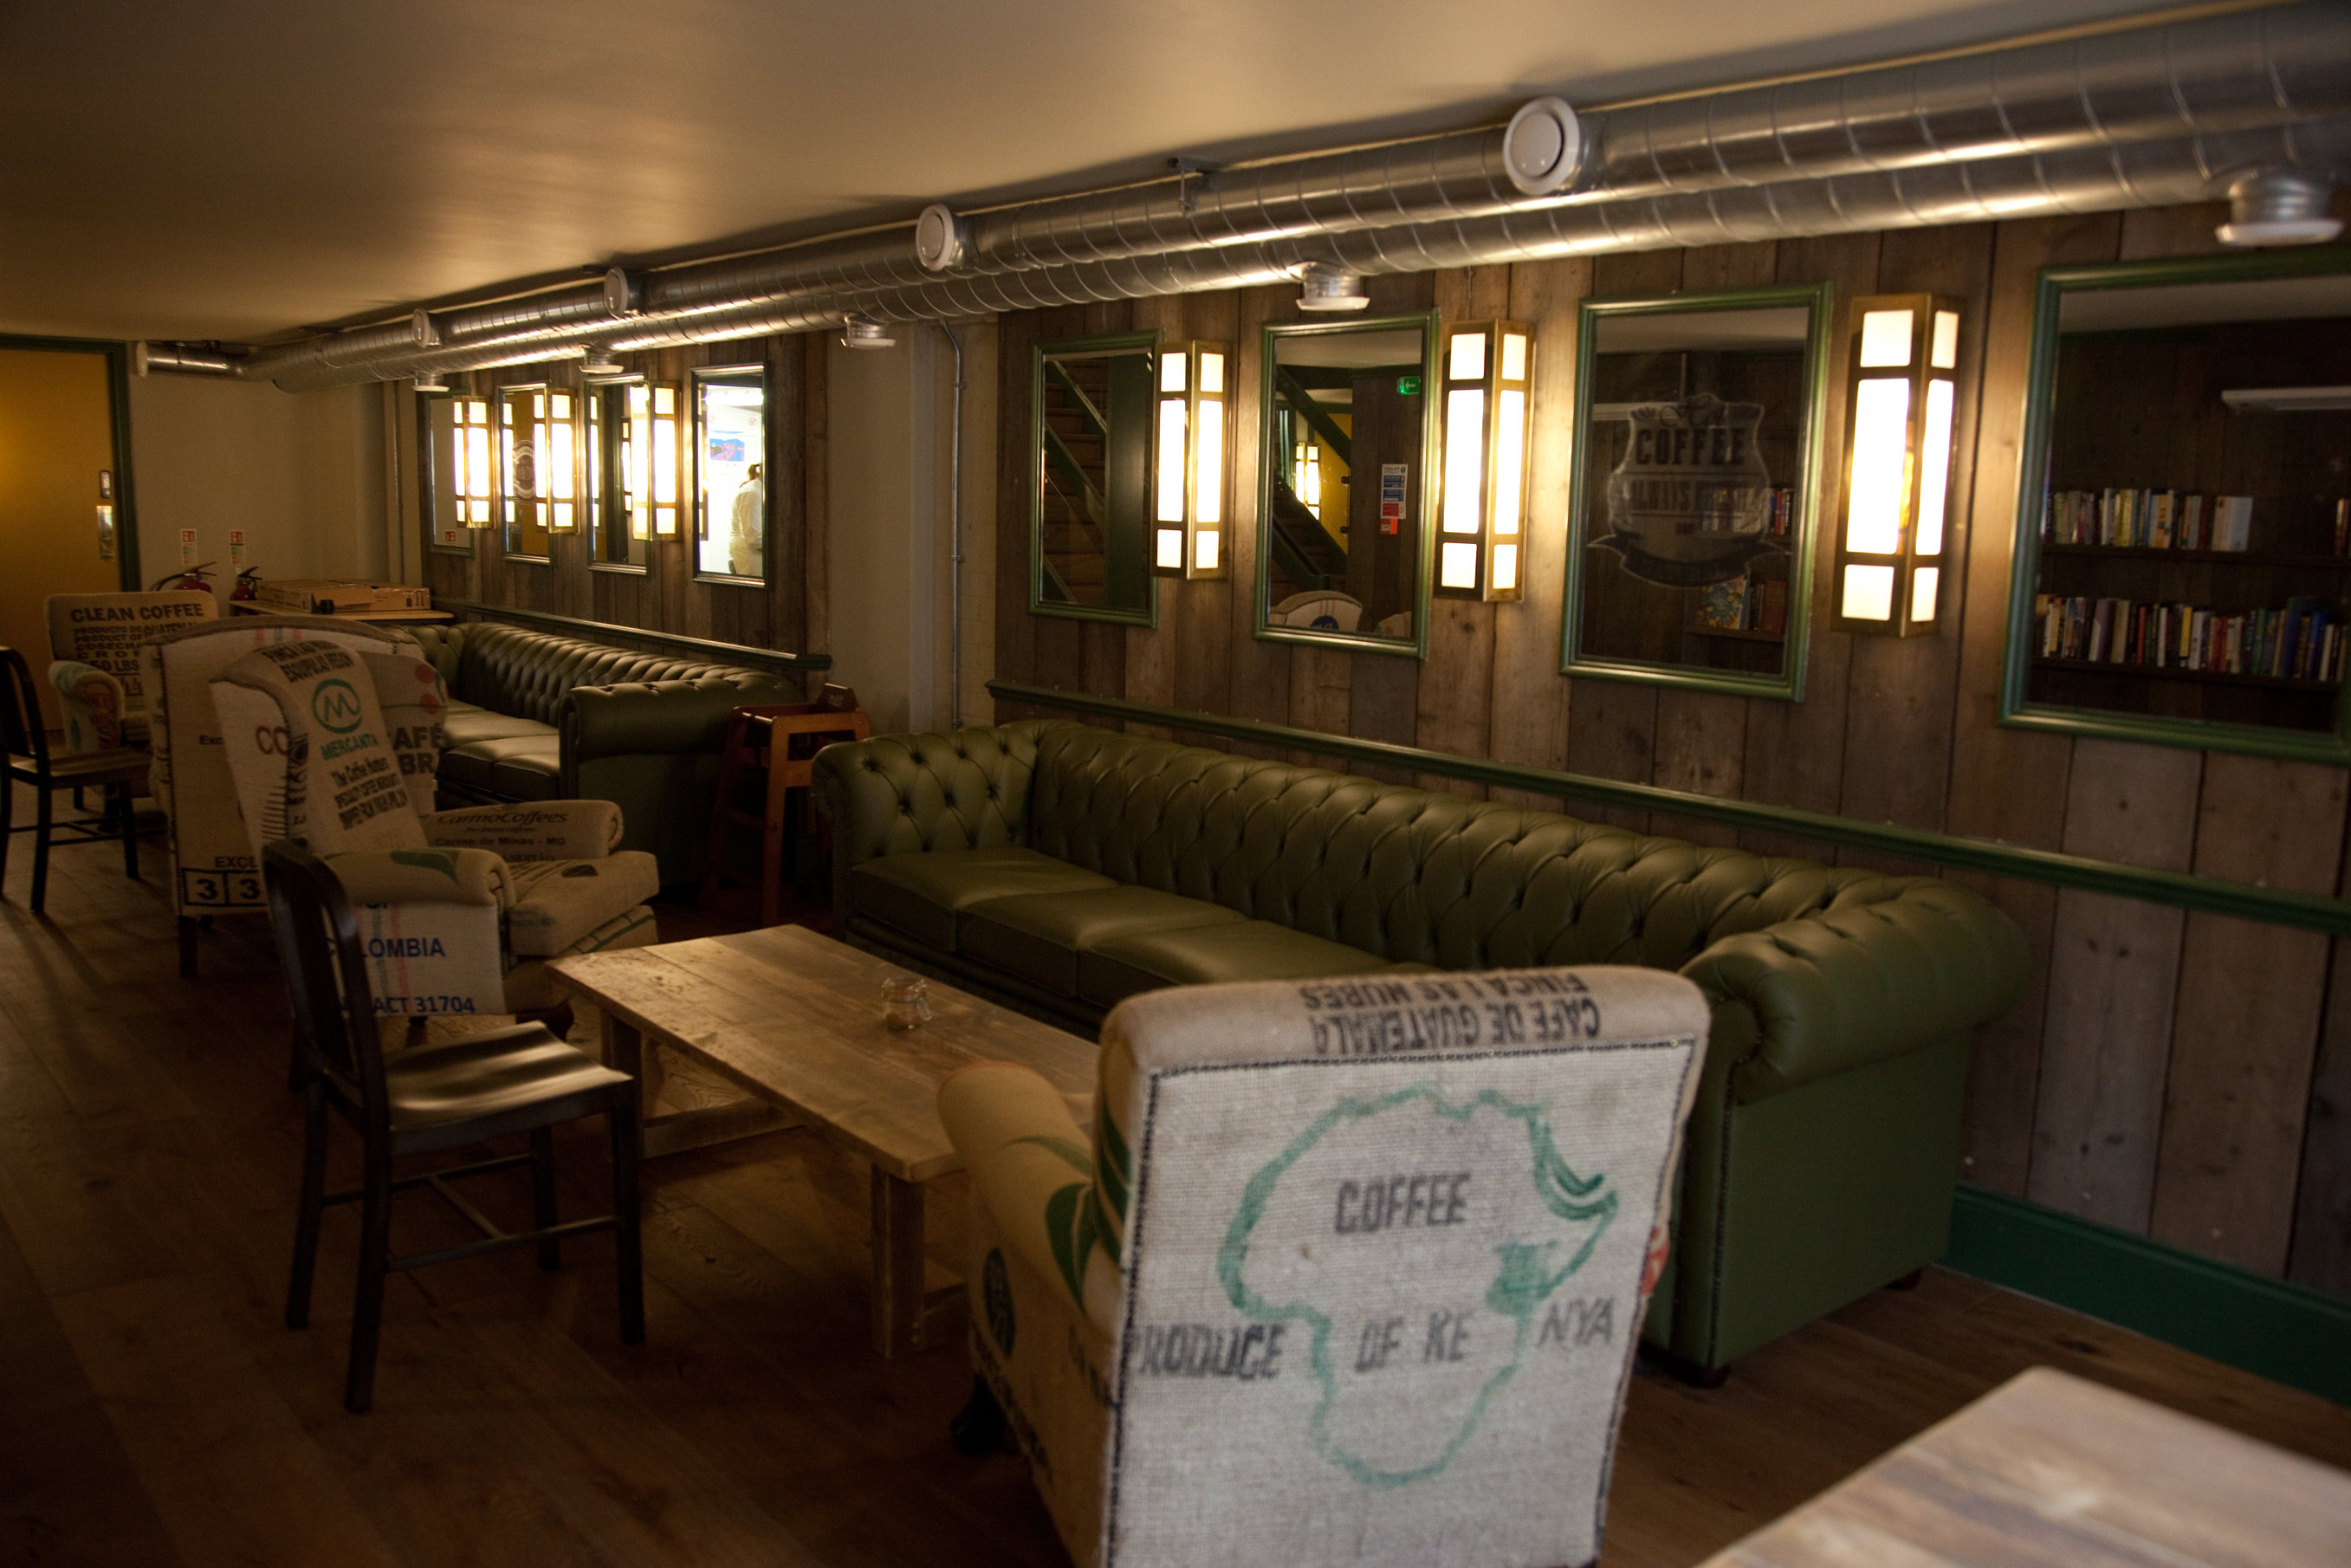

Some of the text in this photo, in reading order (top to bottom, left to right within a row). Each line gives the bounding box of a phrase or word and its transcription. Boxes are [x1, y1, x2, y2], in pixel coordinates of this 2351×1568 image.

[1636, 428, 1745, 465] COFFEE
[71, 603, 204, 622] CLEAN COFFEE
[74, 625, 126, 634] PRODUCTO
[75, 634, 126, 644] PRODUCT
[113, 659, 140, 672] LBS
[392, 722, 444, 750] AFÉ
[320, 734, 379, 761] MERCANTA
[437, 810, 568, 826] CarmoCoffees
[480, 837, 494, 846] de
[498, 836, 534, 846] Minas
[196, 878, 260, 900] 3 3
[362, 937, 446, 958] OMBIA
[1298, 982, 1411, 1010] NUBES
[1487, 973, 1589, 997] FINCA
[415, 996, 475, 1014] 31704
[1308, 998, 1600, 1055] CAFE DE GUATEMALA
[1335, 1173, 1471, 1235] COFFEE
[1355, 1317, 1407, 1373] OF
